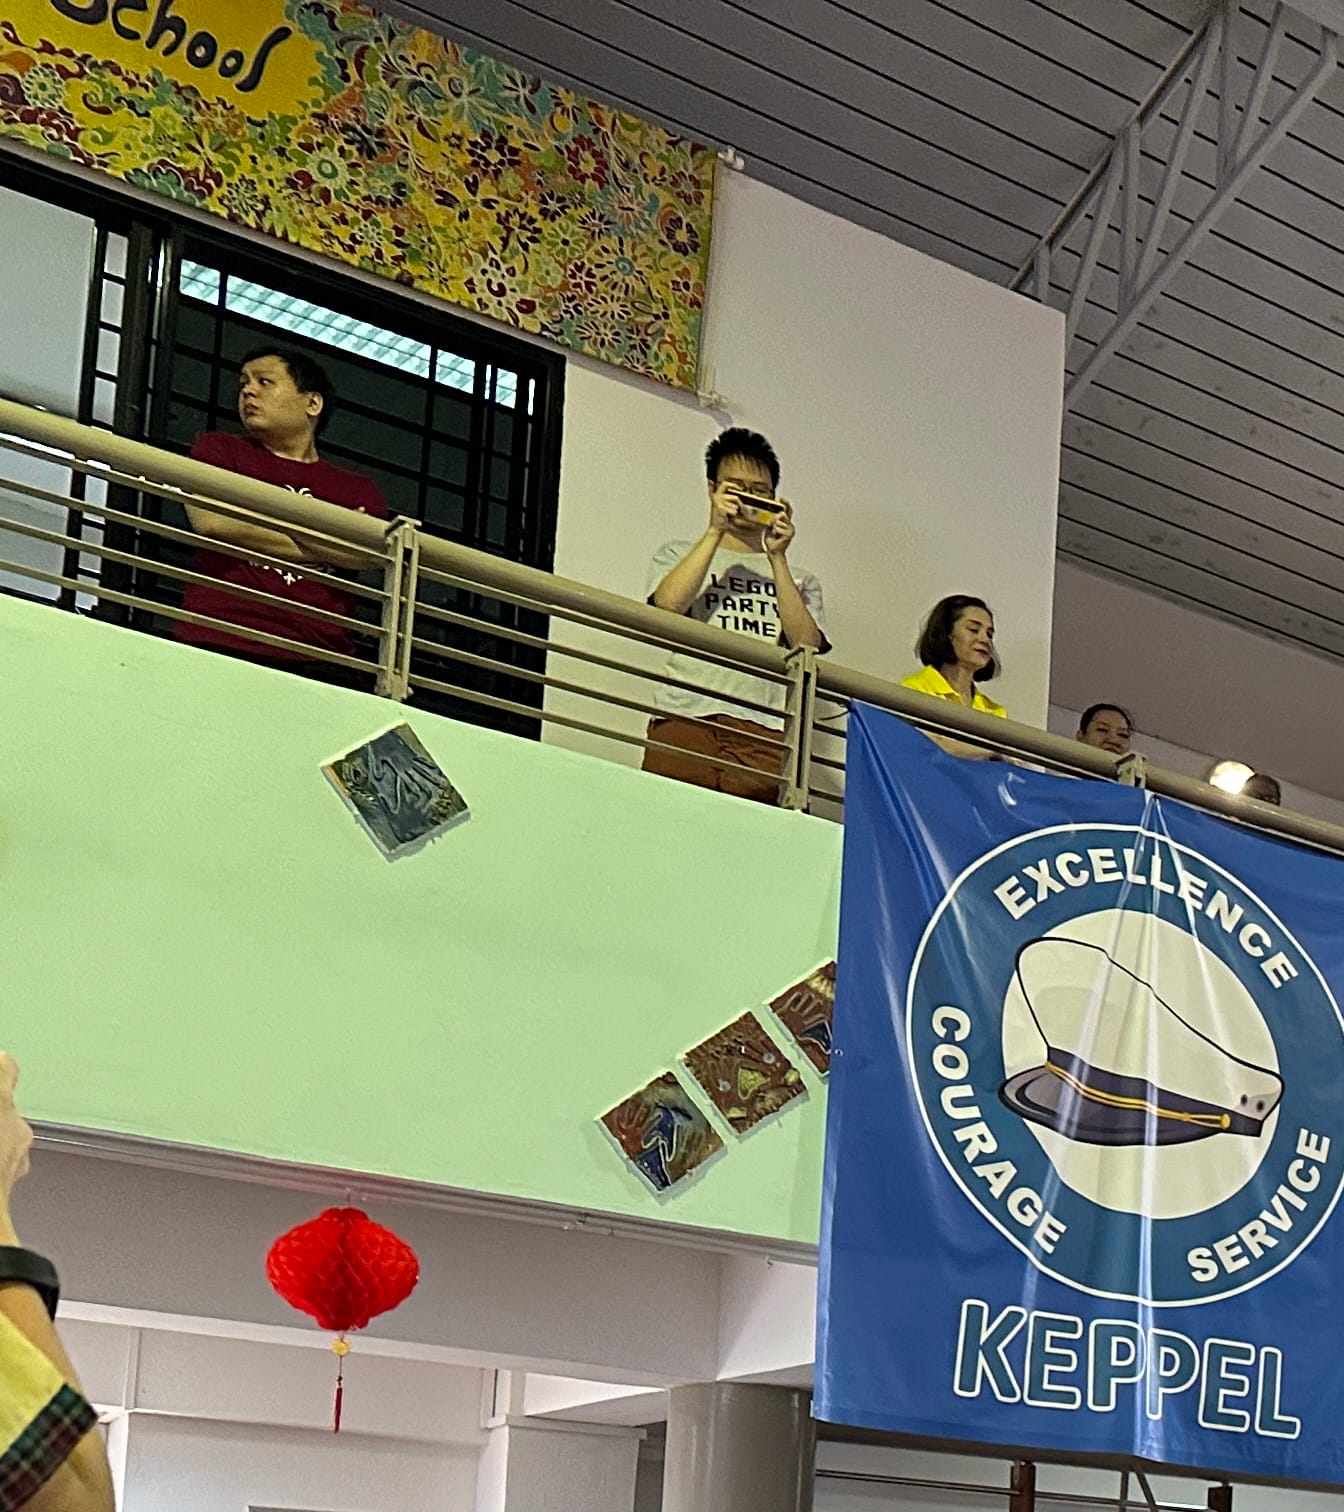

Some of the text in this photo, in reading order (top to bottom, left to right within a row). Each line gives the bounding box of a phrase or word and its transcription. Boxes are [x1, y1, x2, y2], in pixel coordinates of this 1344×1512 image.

[711, 573, 777, 598] LEGO
[717, 615, 777, 638] TIME
[994, 846, 1299, 990] EXCELLENCE
[930, 1004, 1067, 1256] COURAGE
[1187, 1127, 1332, 1284] SERVICE
[952, 1299, 1302, 1441] KEPPEL
